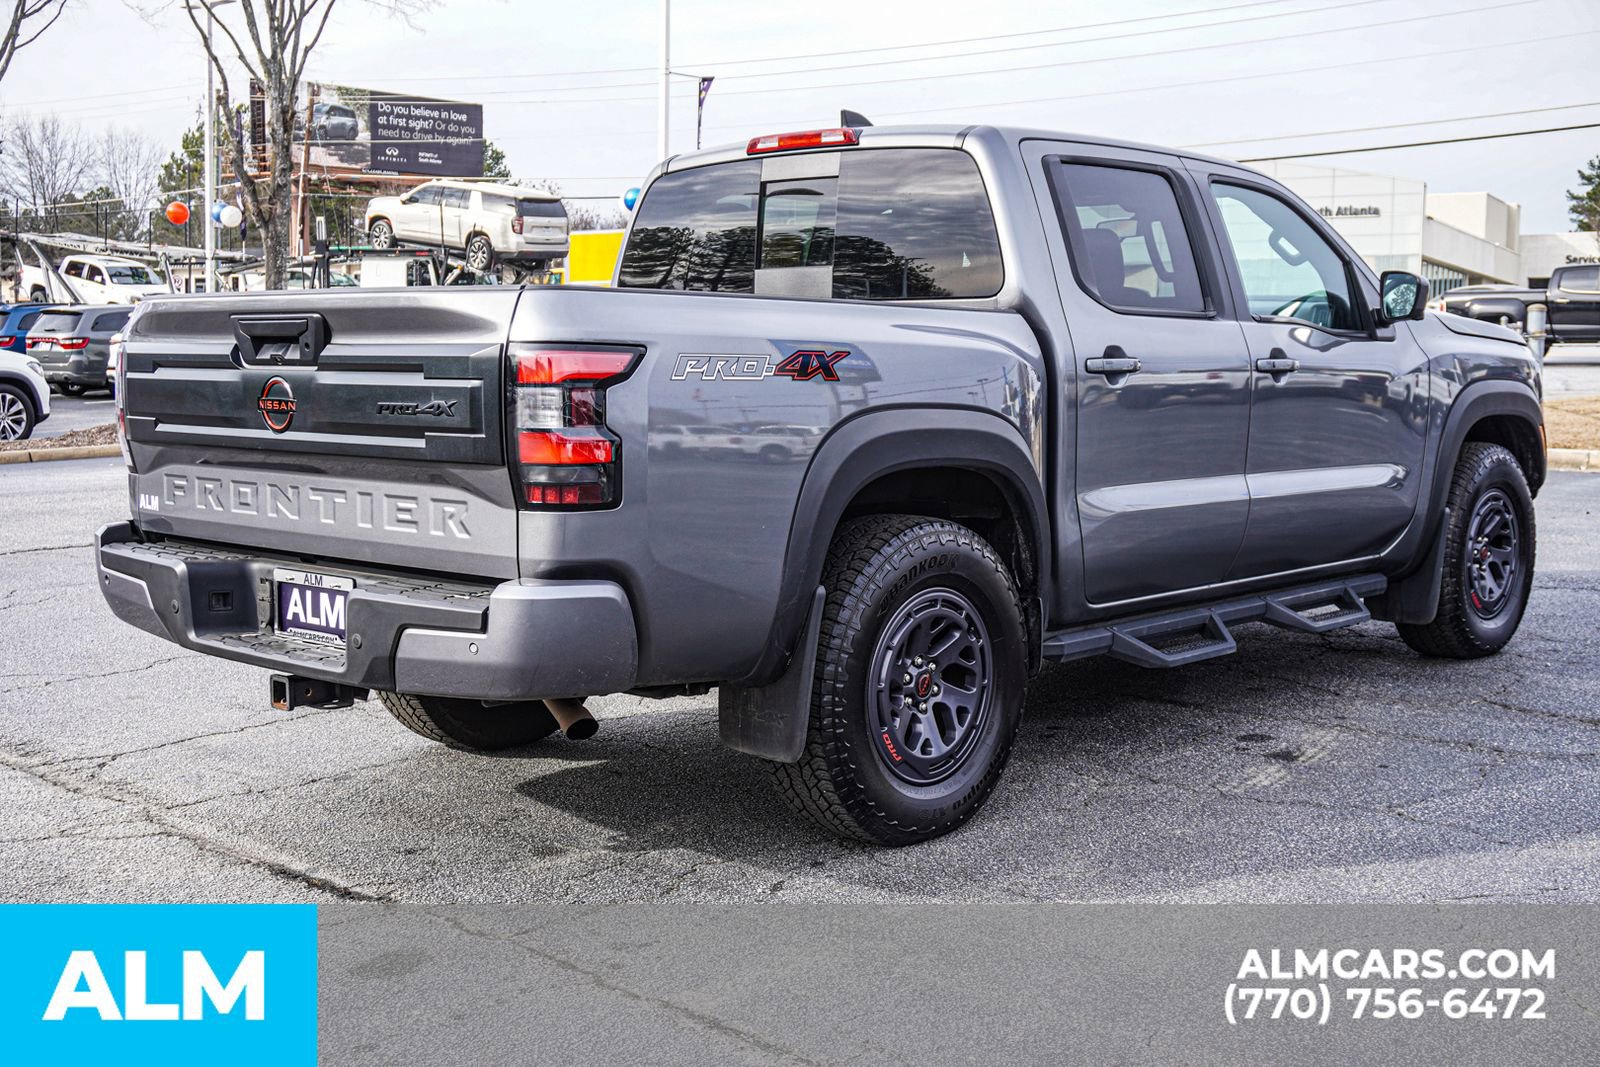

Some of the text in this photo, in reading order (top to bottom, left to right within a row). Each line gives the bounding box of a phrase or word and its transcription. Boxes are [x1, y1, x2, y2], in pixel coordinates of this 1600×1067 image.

[378, 102, 467, 121] Do you believe in love
[378, 116, 475, 134] at first sight? Or do you
[378, 128, 399, 137] need
[401, 130, 410, 139] to
[412, 131, 433, 141] drive
[1335, 204, 1380, 216] Atlanta
[259, 399, 296, 412] NISSAN
[139, 493, 159, 511] ALM
[163, 473, 472, 539] FRONTIER
[303, 573, 323, 587] ALM
[286, 587, 345, 630] ALM
